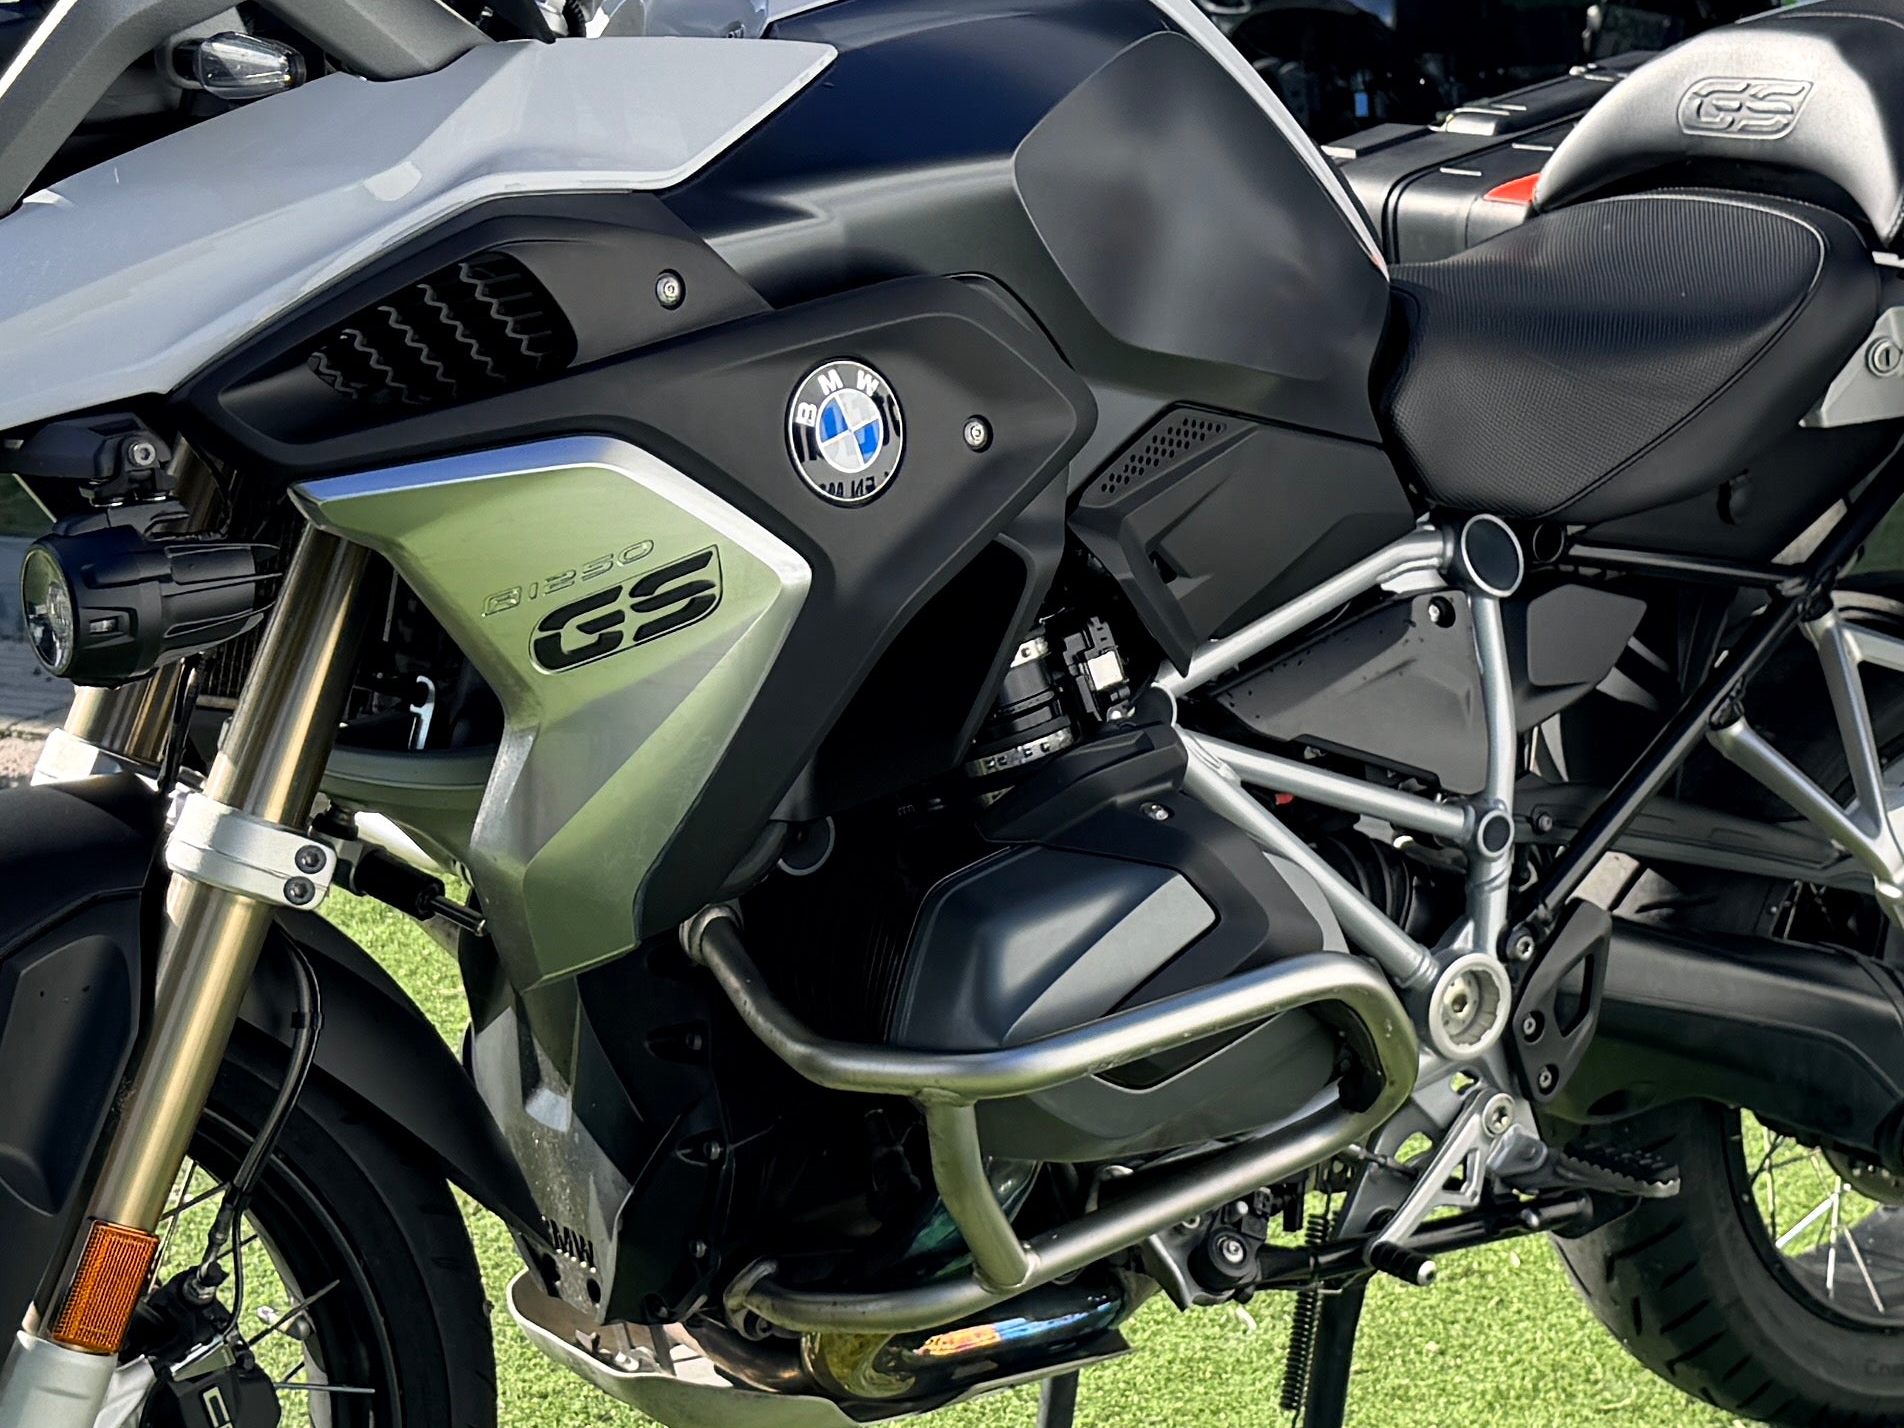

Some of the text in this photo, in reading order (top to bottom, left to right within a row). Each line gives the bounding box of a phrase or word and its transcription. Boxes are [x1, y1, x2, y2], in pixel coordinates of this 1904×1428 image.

[1682, 81, 1807, 134] GS
[795, 368, 880, 428] BMW
[532, 549, 718, 671] GS
[546, 1218, 595, 1269] MW
